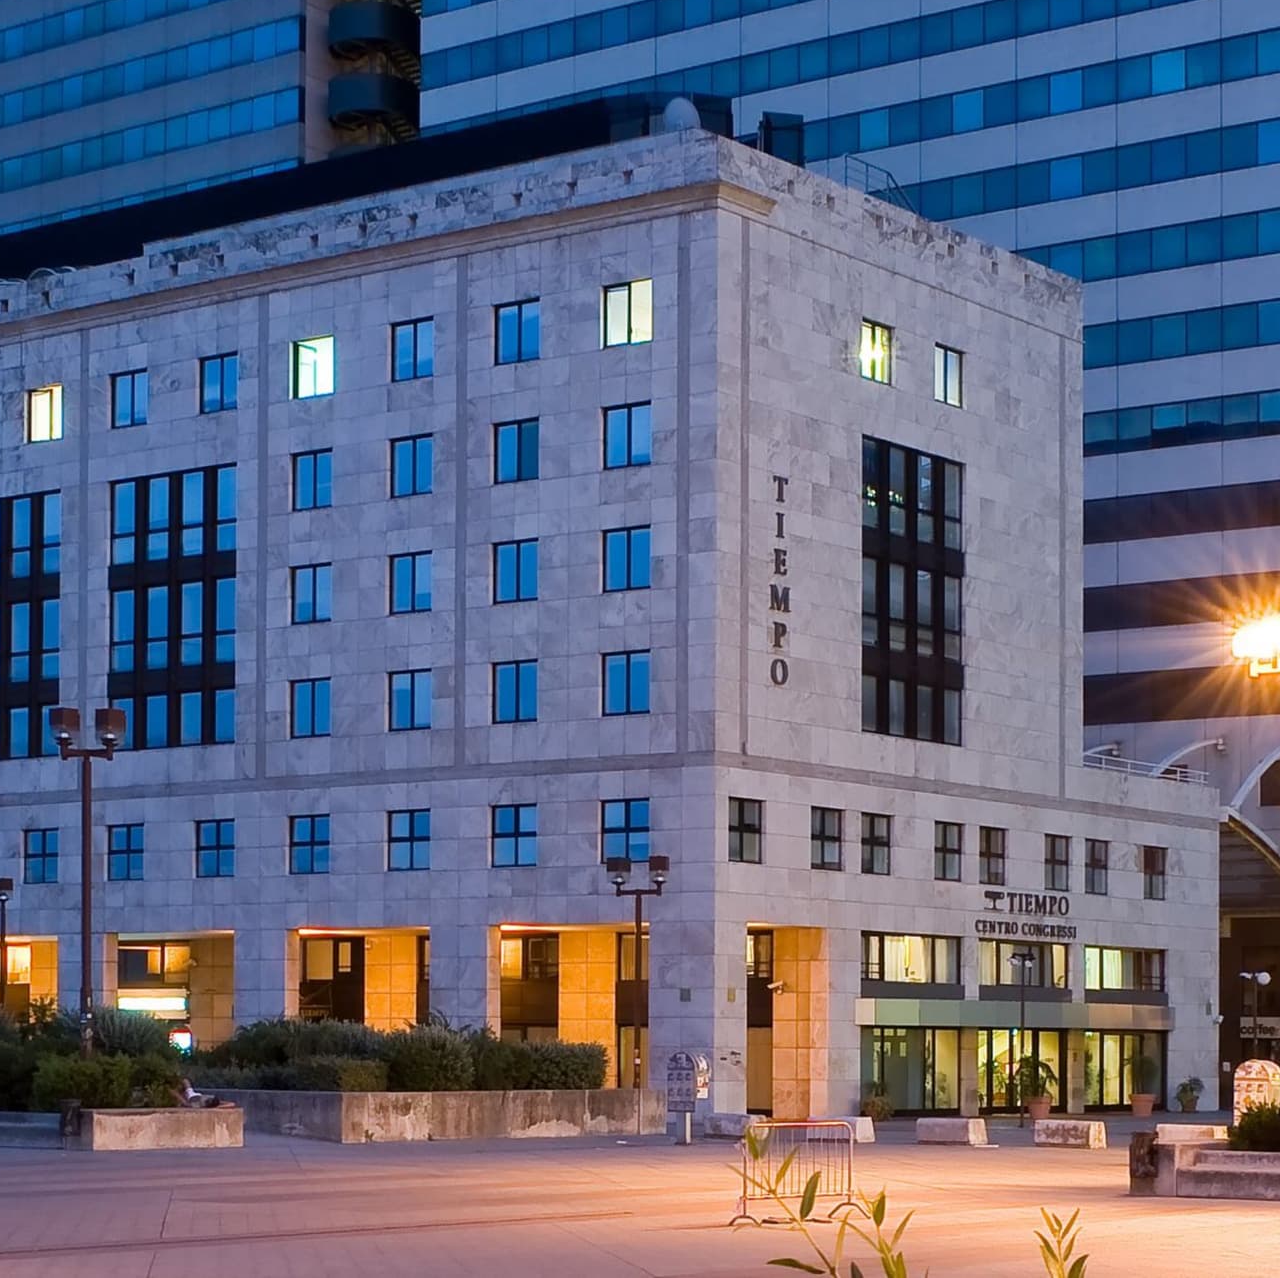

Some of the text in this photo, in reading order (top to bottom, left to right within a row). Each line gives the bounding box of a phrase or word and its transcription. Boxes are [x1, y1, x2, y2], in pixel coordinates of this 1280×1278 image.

[769, 475, 791, 685] TIEMPO
[1007, 892, 1069, 915] TIEMPO
[975, 919, 1077, 939] CENTRO CONGRESSI
[1240, 1023, 1276, 1035] cofee
